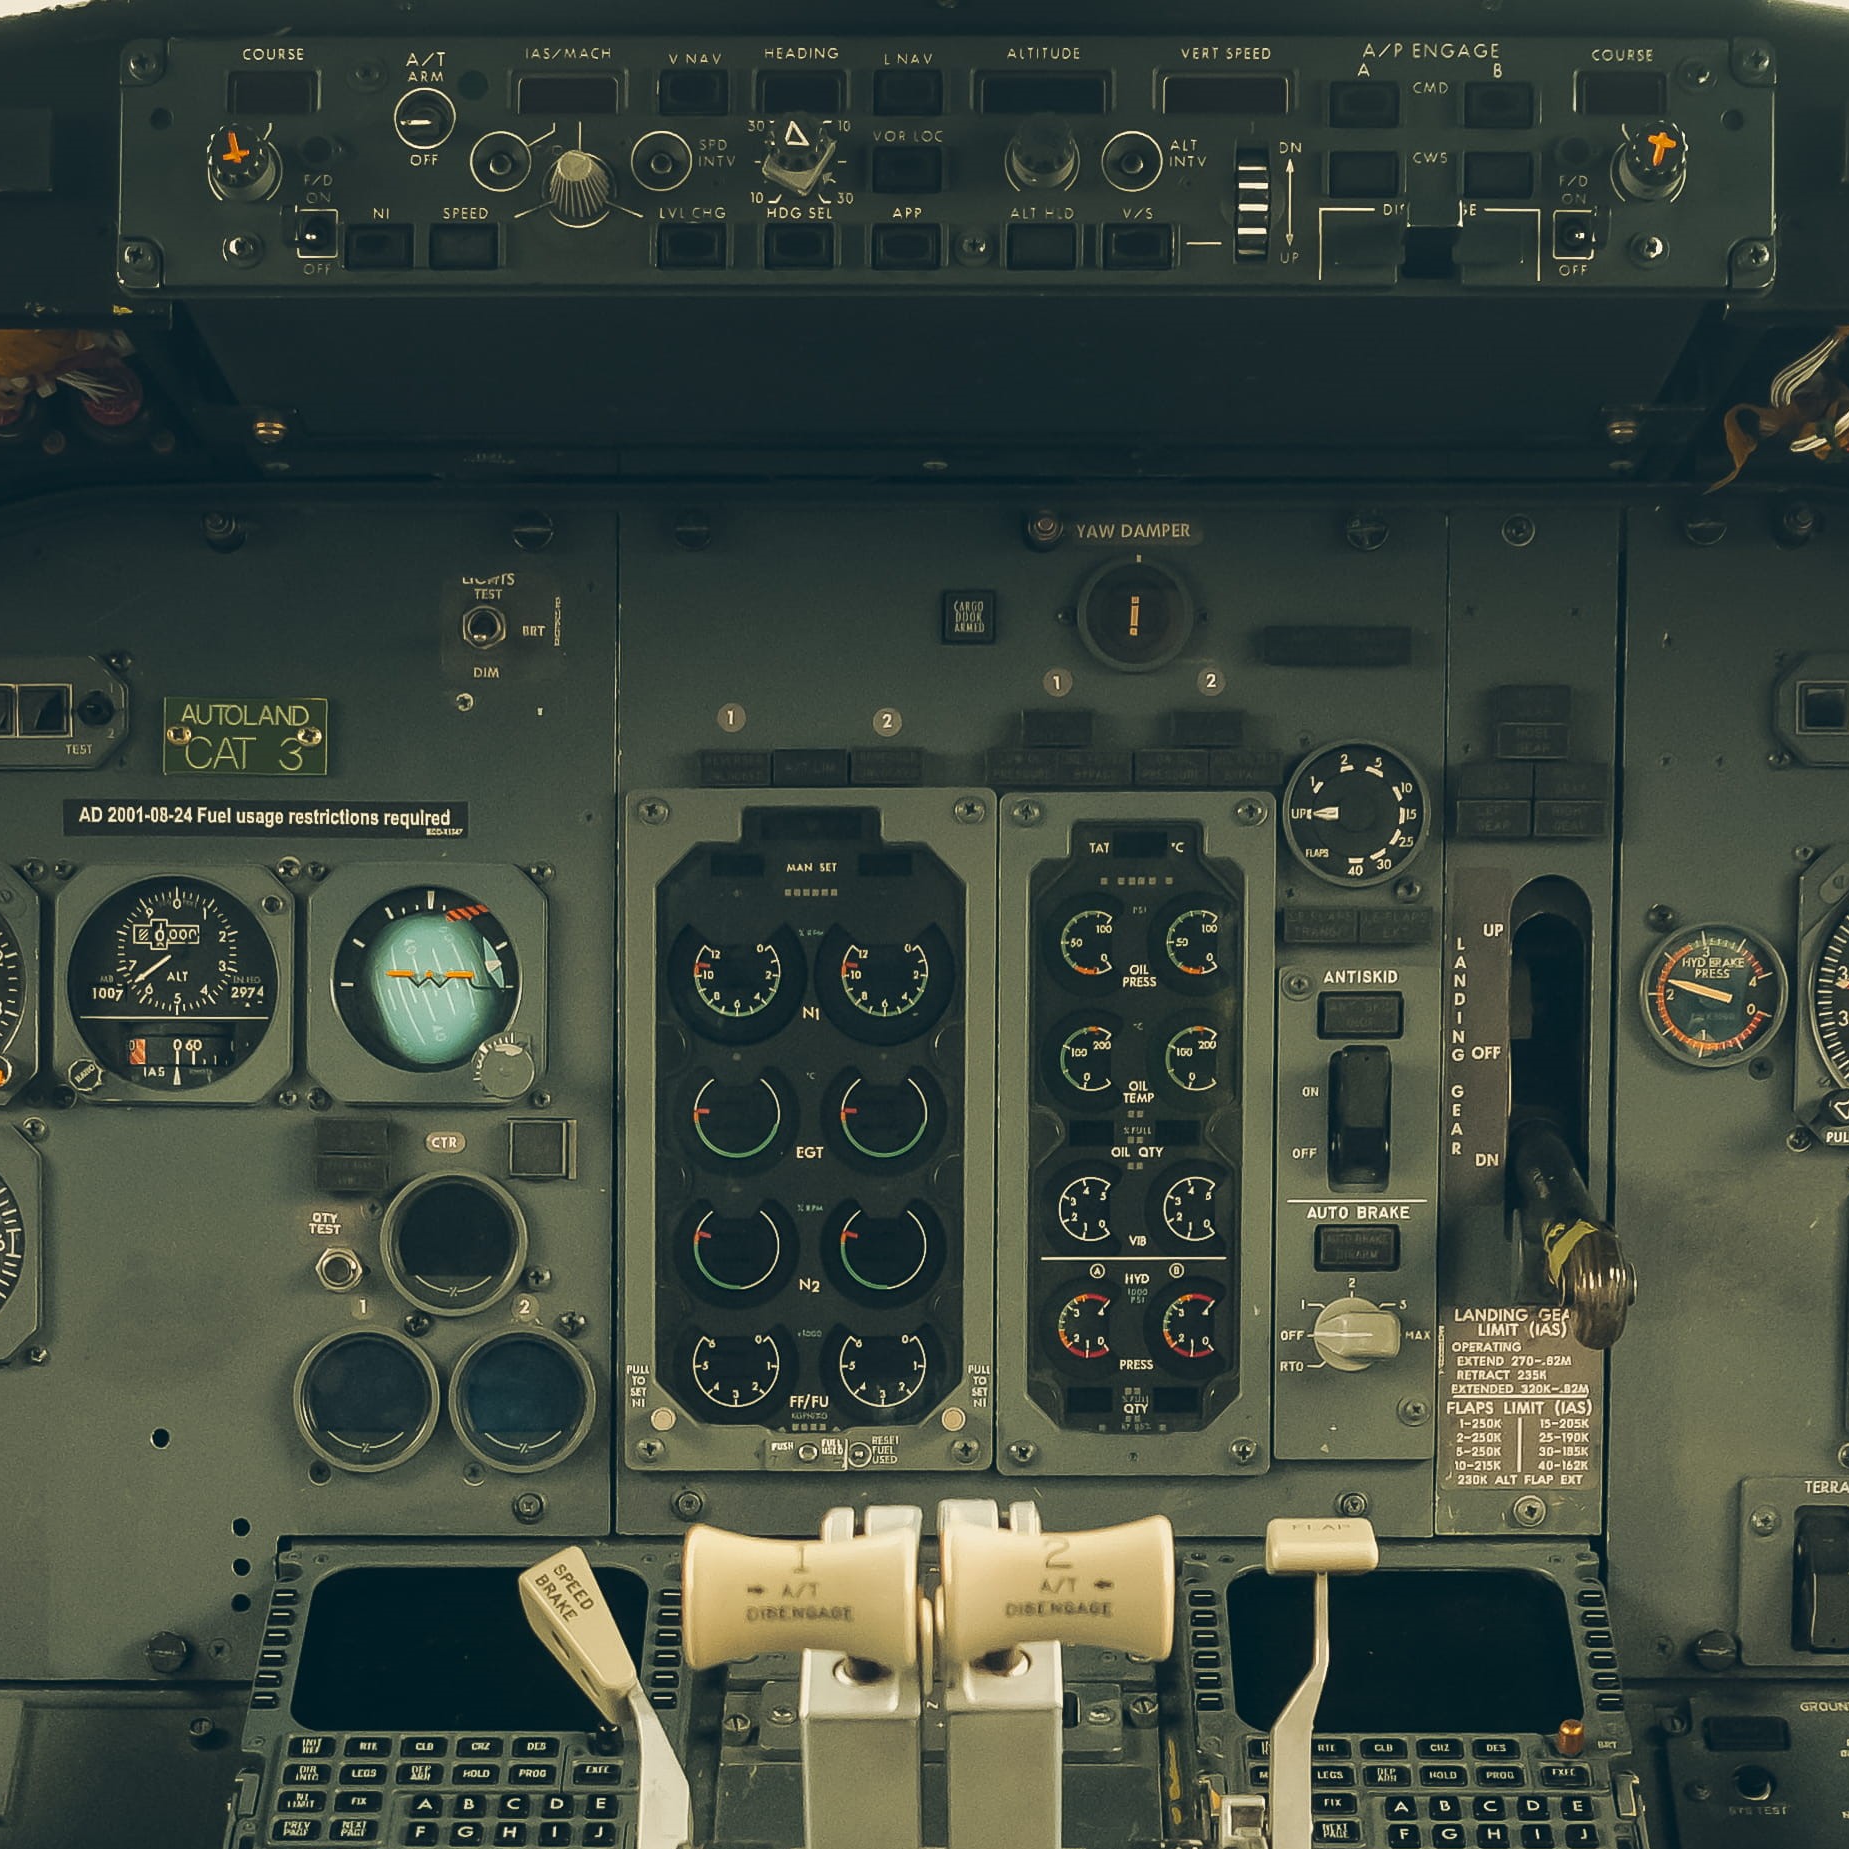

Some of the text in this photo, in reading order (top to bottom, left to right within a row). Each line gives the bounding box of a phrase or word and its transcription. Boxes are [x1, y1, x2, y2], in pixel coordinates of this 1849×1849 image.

[243, 49, 304, 60] COURSE
[525, 47, 612, 60] IAS/MACH
[765, 48, 839, 60] HEADING
[1007, 47, 1081, 60] ALTITUDE
[1181, 47, 1271, 60] VERT SPEED
[1364, 42, 1499, 59] A/P ENGAGE
[1592, 49, 1654, 62] COURSE
[406, 52, 446, 66] A/T
[669, 53, 723, 65] V NAV
[884, 53, 933, 65] L NAV
[408, 71, 444, 82] ARM
[1357, 63, 1371, 77] A
[1493, 63, 1502, 78] B
[1413, 81, 1448, 95] CMD
[410, 154, 439, 165] OFF
[1413, 151, 1448, 164] CWS
[444, 208, 489, 219] SPEED
[659, 208, 725, 220] LVL CHG
[767, 206, 833, 219] HDG SEL
[892, 208, 923, 219] APP
[1011, 207, 1073, 220] ALT HLD
[1123, 207, 1153, 220] V/S
[1076, 523, 1190, 538] YAW DAMPER
[181, 704, 309, 726] AUTOLAND
[184, 737, 302, 770] CAT 3
[79, 807, 450, 829] AD 2001-08-24 Fuel usage restrictions required
[1324, 970, 1398, 984] ANTISKID
[432, 1137, 456, 1149] CTR
[796, 1147, 823, 1160] EGT
[1111, 1146, 1163, 1160] OIL QTY
[313, 1213, 338, 1226] QTY
[1308, 1207, 1410, 1220] AUTO BRAKE
[308, 1224, 341, 1236] TEST
[799, 1278, 820, 1292] N2
[1455, 1309, 1570, 1322] LANDING GEA
[1280, 1331, 1304, 1341] OFF
[1405, 1331, 1431, 1341] MAX
[1478, 1322, 1567, 1338] LIMIT (IAS)
[1452, 1342, 1522, 1353] OPERATING
[1280, 1362, 1304, 1372] RTO
[1457, 1356, 1504, 1367] EXTEND
[1457, 1370, 1546, 1381] RETRACT 235K
[1452, 1384, 1513, 1395] EXTENDED
[789, 1395, 828, 1409] FF/FU
[1446, 1400, 1592, 1416] FLAPS LIMIT (IAS)
[1459, 1419, 1502, 1429] 1-250K
[1539, 1419, 1589, 1429] 15-205K
[1456, 1433, 1502, 1443] 2-250K
[1539, 1433, 1589, 1443] 25-190K
[1456, 1447, 1502, 1457] 5-250K
[1539, 1447, 1589, 1457] 30-185K
[1454, 1461, 1501, 1471] 10-215K
[1538, 1461, 1589, 1471] 40-162K
[1457, 1474, 1583, 1485] 230K ALT FLAP EXT
[553, 1563, 596, 1612] SPEED
[534, 1573, 579, 1622] BRAKE
